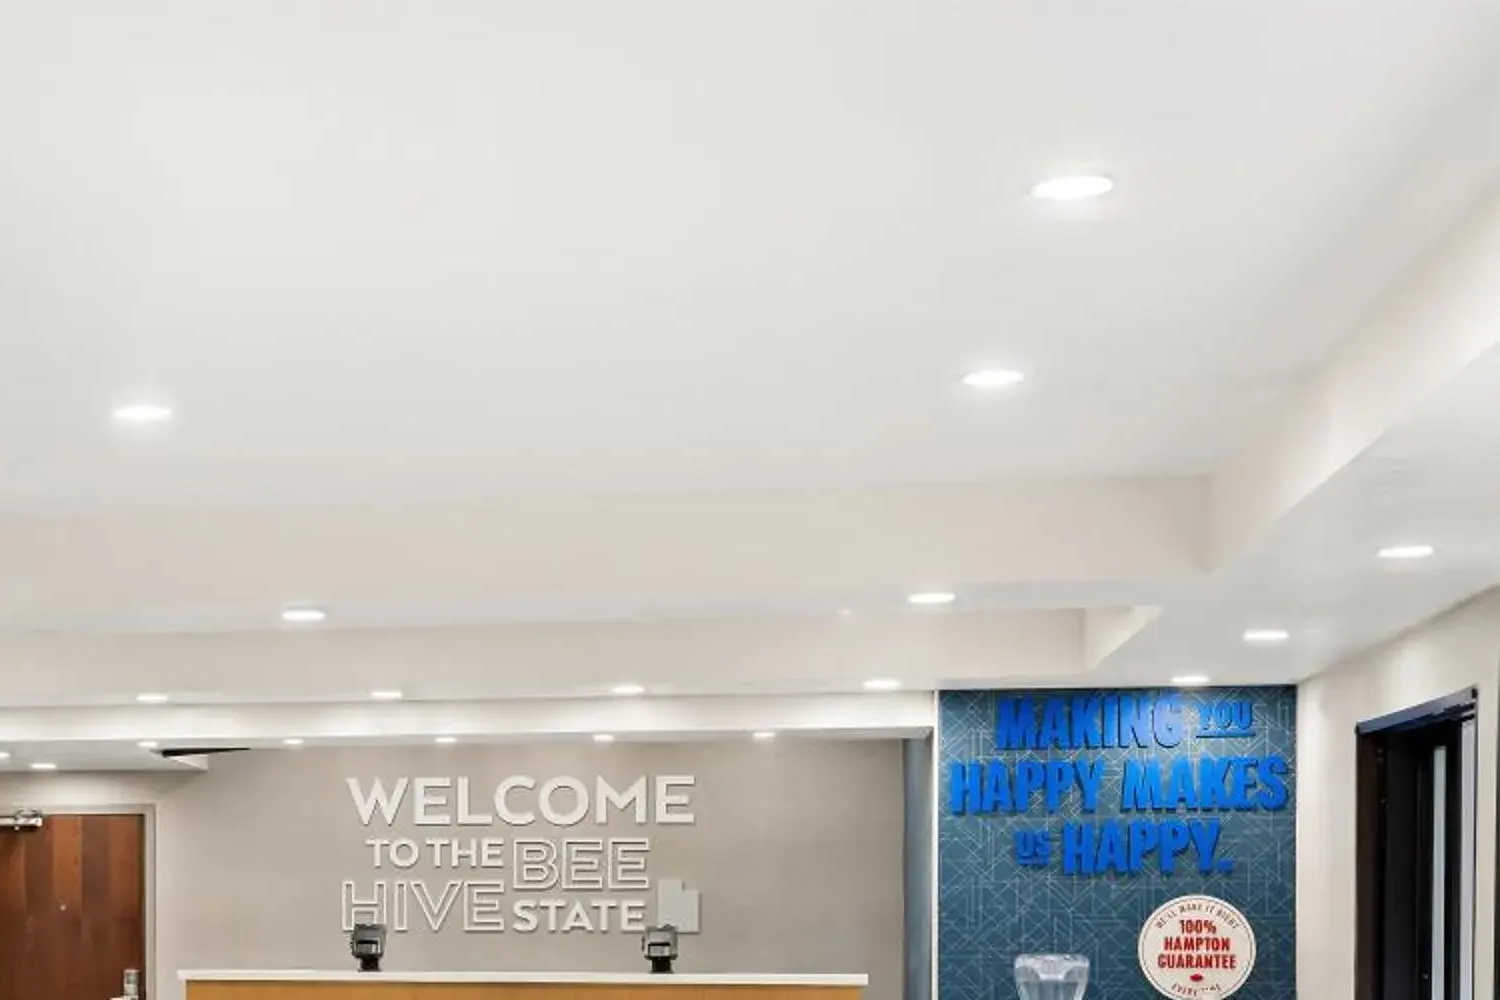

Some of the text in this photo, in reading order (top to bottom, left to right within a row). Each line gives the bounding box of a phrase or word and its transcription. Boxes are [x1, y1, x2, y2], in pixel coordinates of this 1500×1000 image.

[996, 695, 1254, 750] MAKING YOU
[346, 774, 696, 826] WELCOME
[950, 754, 1290, 814] HAPPY MAKES
[364, 837, 651, 891] TO THE BEE
[1062, 818, 1235, 876] HAPPY.
[341, 879, 647, 933] HIVE STATE
[1179, 919, 1217, 934] 100%
[1157, 953, 1238, 969] GUARANTEE
[1163, 936, 1231, 951] HAMPTON
